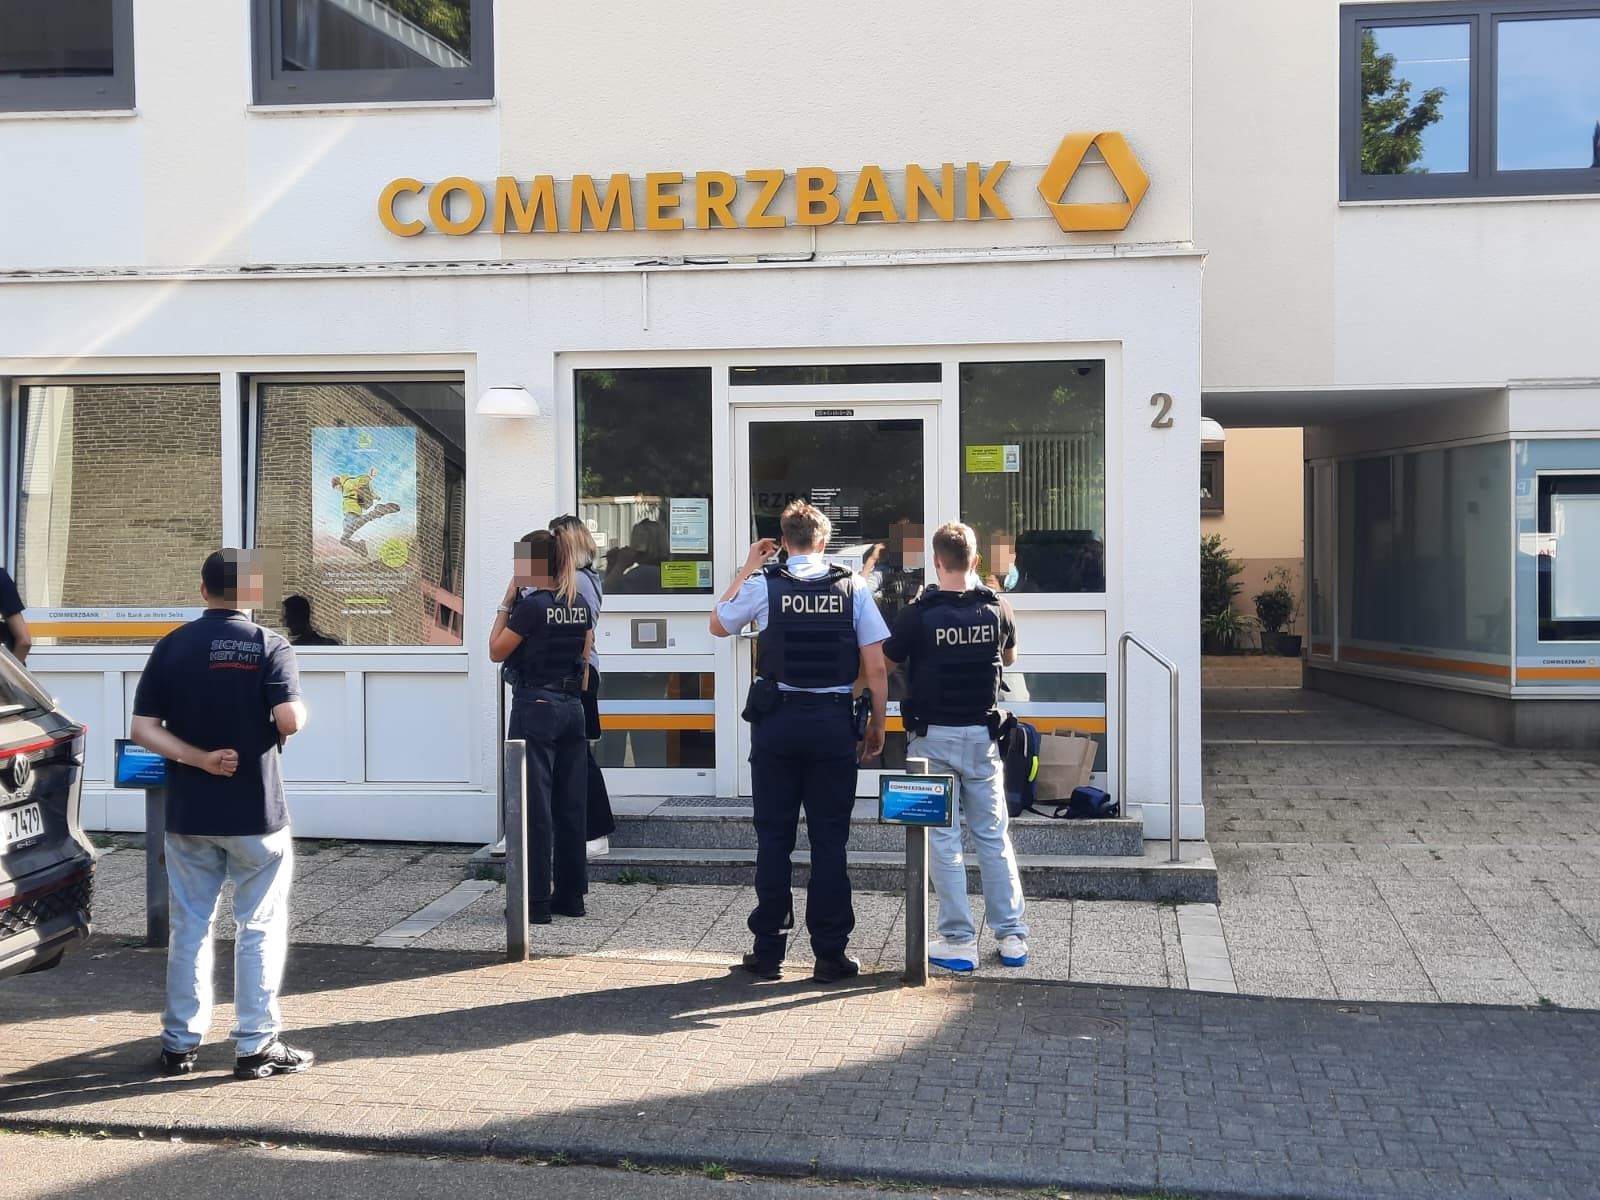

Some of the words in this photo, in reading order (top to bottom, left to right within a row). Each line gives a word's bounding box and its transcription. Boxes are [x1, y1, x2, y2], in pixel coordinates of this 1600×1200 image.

[378, 160, 1014, 237] COMMERZBANK
[1150, 392, 1174, 428] 2
[782, 594, 844, 613] POLIZEI
[546, 607, 588, 625] POLIZEI
[935, 624, 995, 646] POLIZEI
[211, 639, 262, 653] SICHER
[238, 653, 261, 662] MIT
[889, 783, 933, 792] COMMERZBANK
[11, 806, 40, 838] 7479
